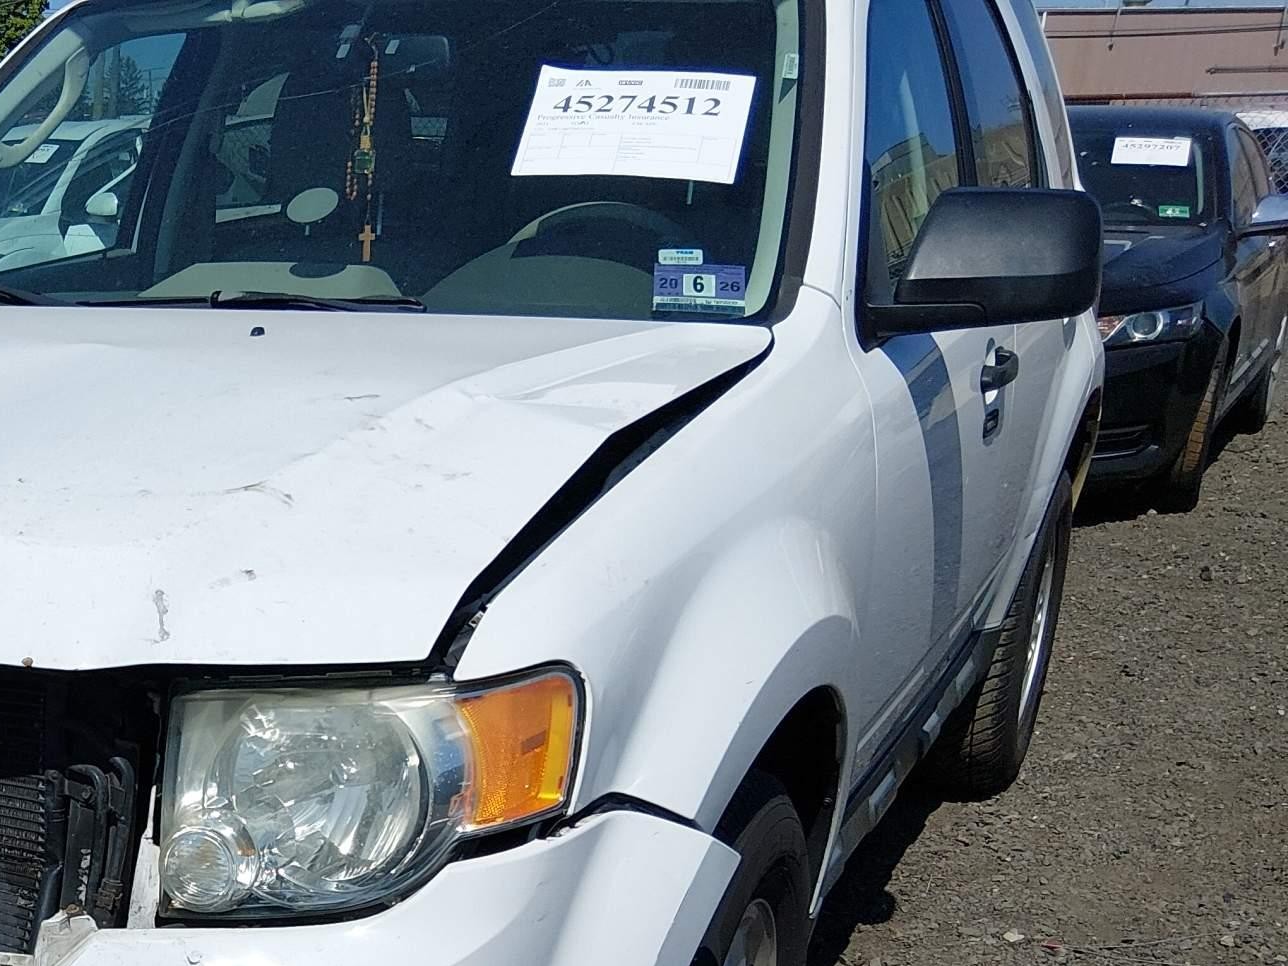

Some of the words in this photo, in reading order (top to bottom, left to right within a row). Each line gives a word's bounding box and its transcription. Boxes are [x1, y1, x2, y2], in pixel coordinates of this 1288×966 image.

[553, 94, 721, 116] 45274512
[659, 277, 678, 289] 20
[693, 275, 705, 293] 6
[719, 281, 741, 292] 26
